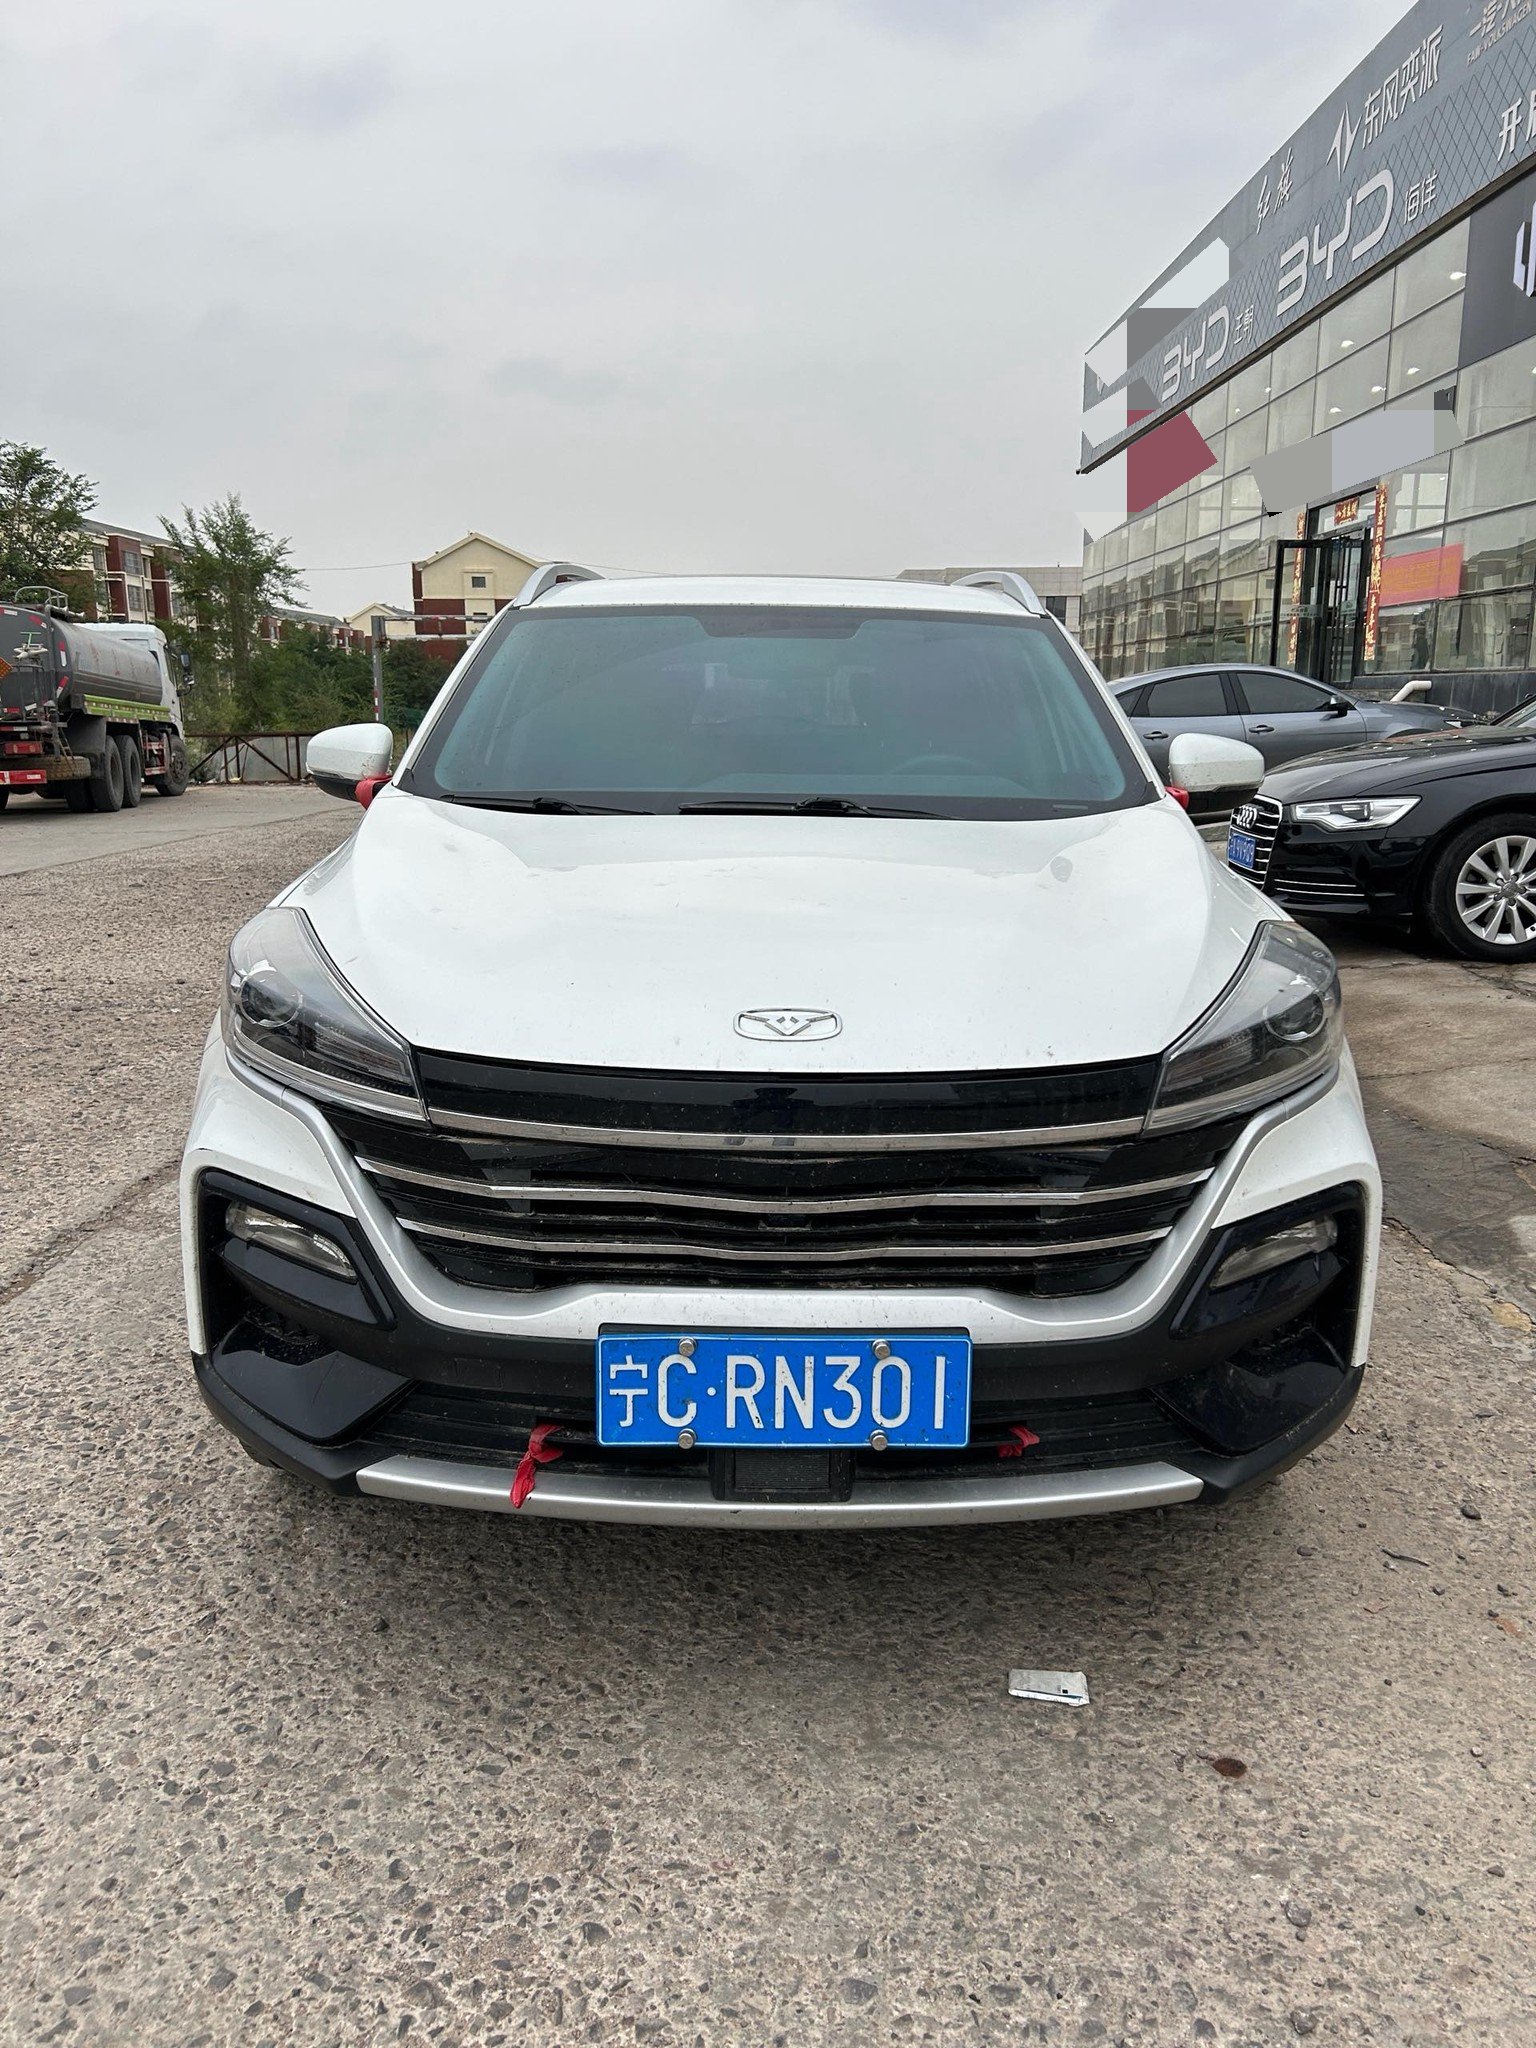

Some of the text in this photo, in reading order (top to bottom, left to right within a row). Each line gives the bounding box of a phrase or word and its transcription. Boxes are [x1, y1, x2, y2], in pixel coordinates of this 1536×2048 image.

[1362, 24, 1444, 149] 东风奕派
[1276, 169, 1439, 317] BYD 海洋
[1162, 305, 1230, 403] BYD
[609, 1353, 946, 1430] 宁C·RN301
